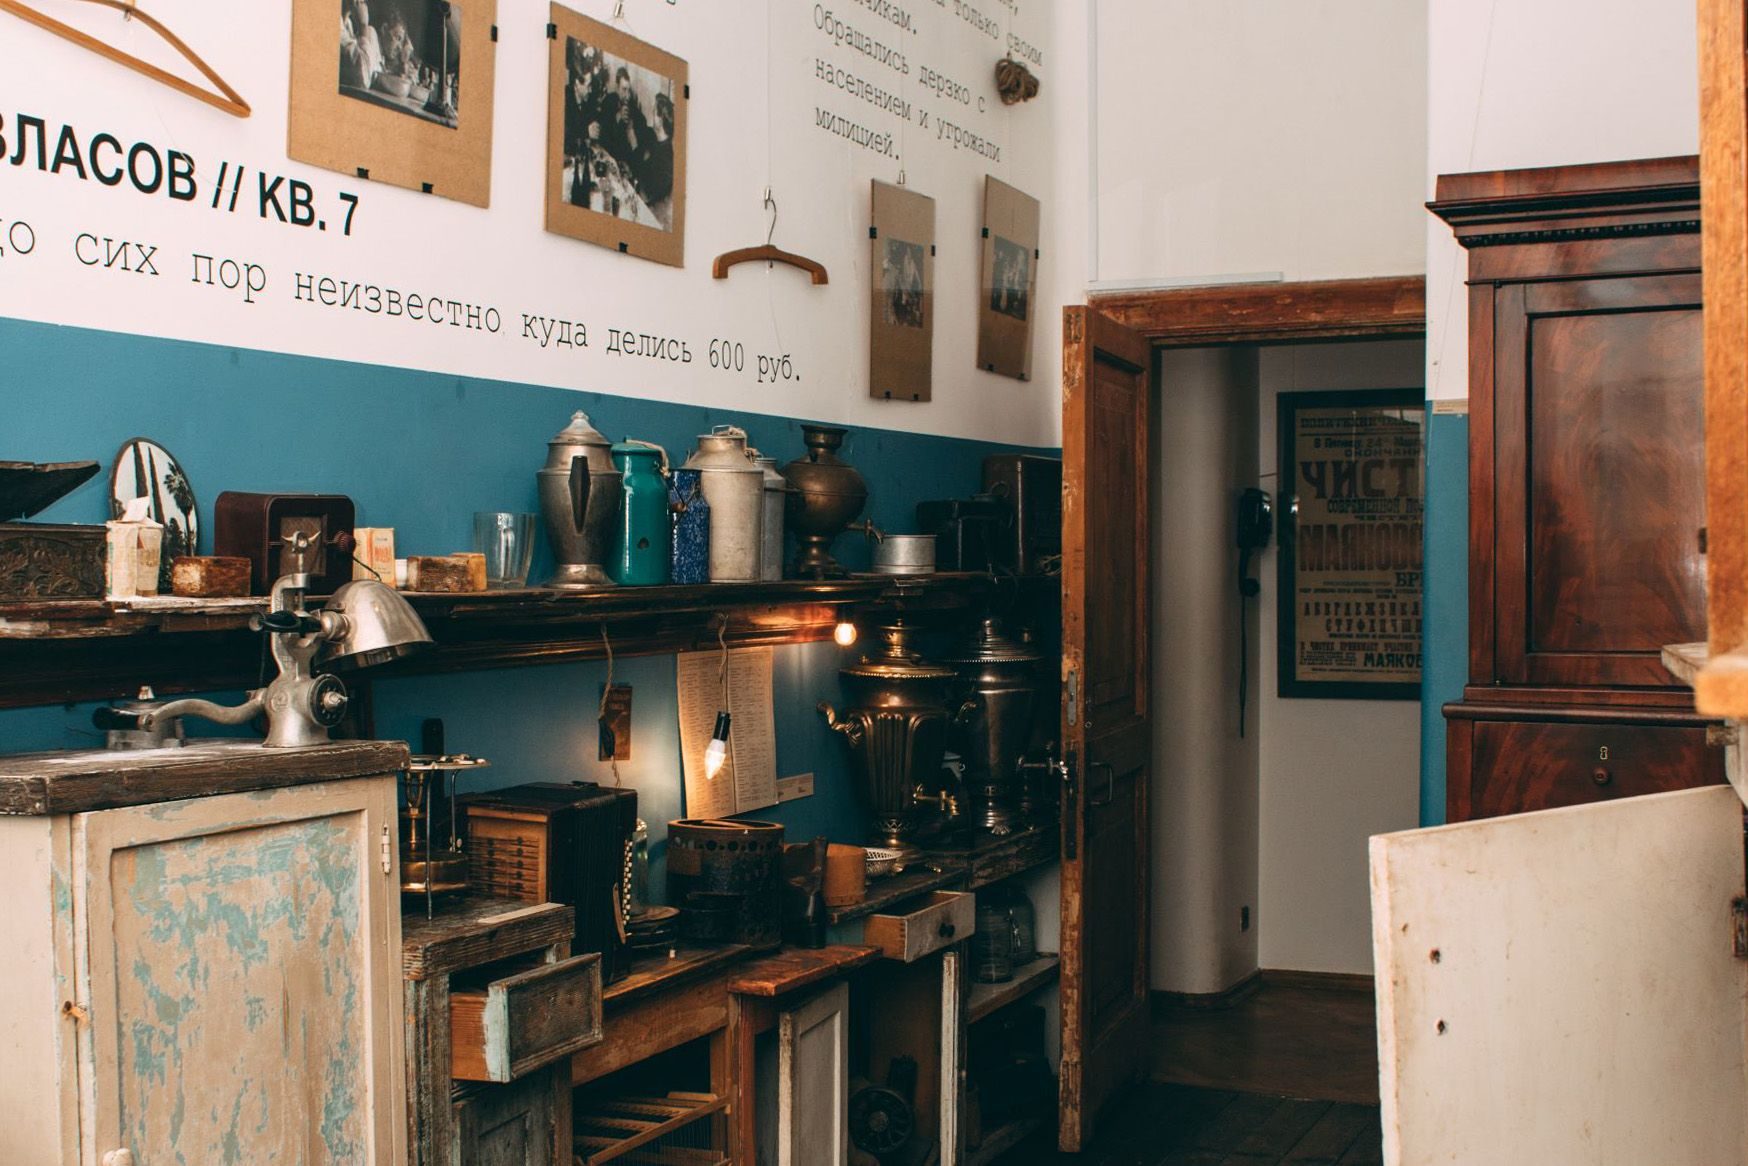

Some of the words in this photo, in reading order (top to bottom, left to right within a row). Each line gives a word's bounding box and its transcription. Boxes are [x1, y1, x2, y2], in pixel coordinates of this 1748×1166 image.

[814, 3, 910, 75] Обращались
[918, 65, 971, 105] дерзко
[977, 95, 986, 113] с
[0, 113, 197, 201] ЛАСОВ
[815, 58, 911, 121] населением
[919, 108, 929, 129] и
[936, 116, 1001, 163] угрожали
[815, 107, 900, 160] милицией.
[75, 233, 160, 276] сих
[191, 253, 267, 304] пор
[294, 272, 501, 333] неизвестно
[521, 312, 588, 348] куда
[606, 327, 693, 364] делись
[708, 338, 745, 373] 600
[757, 353, 800, 384] руб.
[1300, 458, 1416, 499] ЧИСТ
